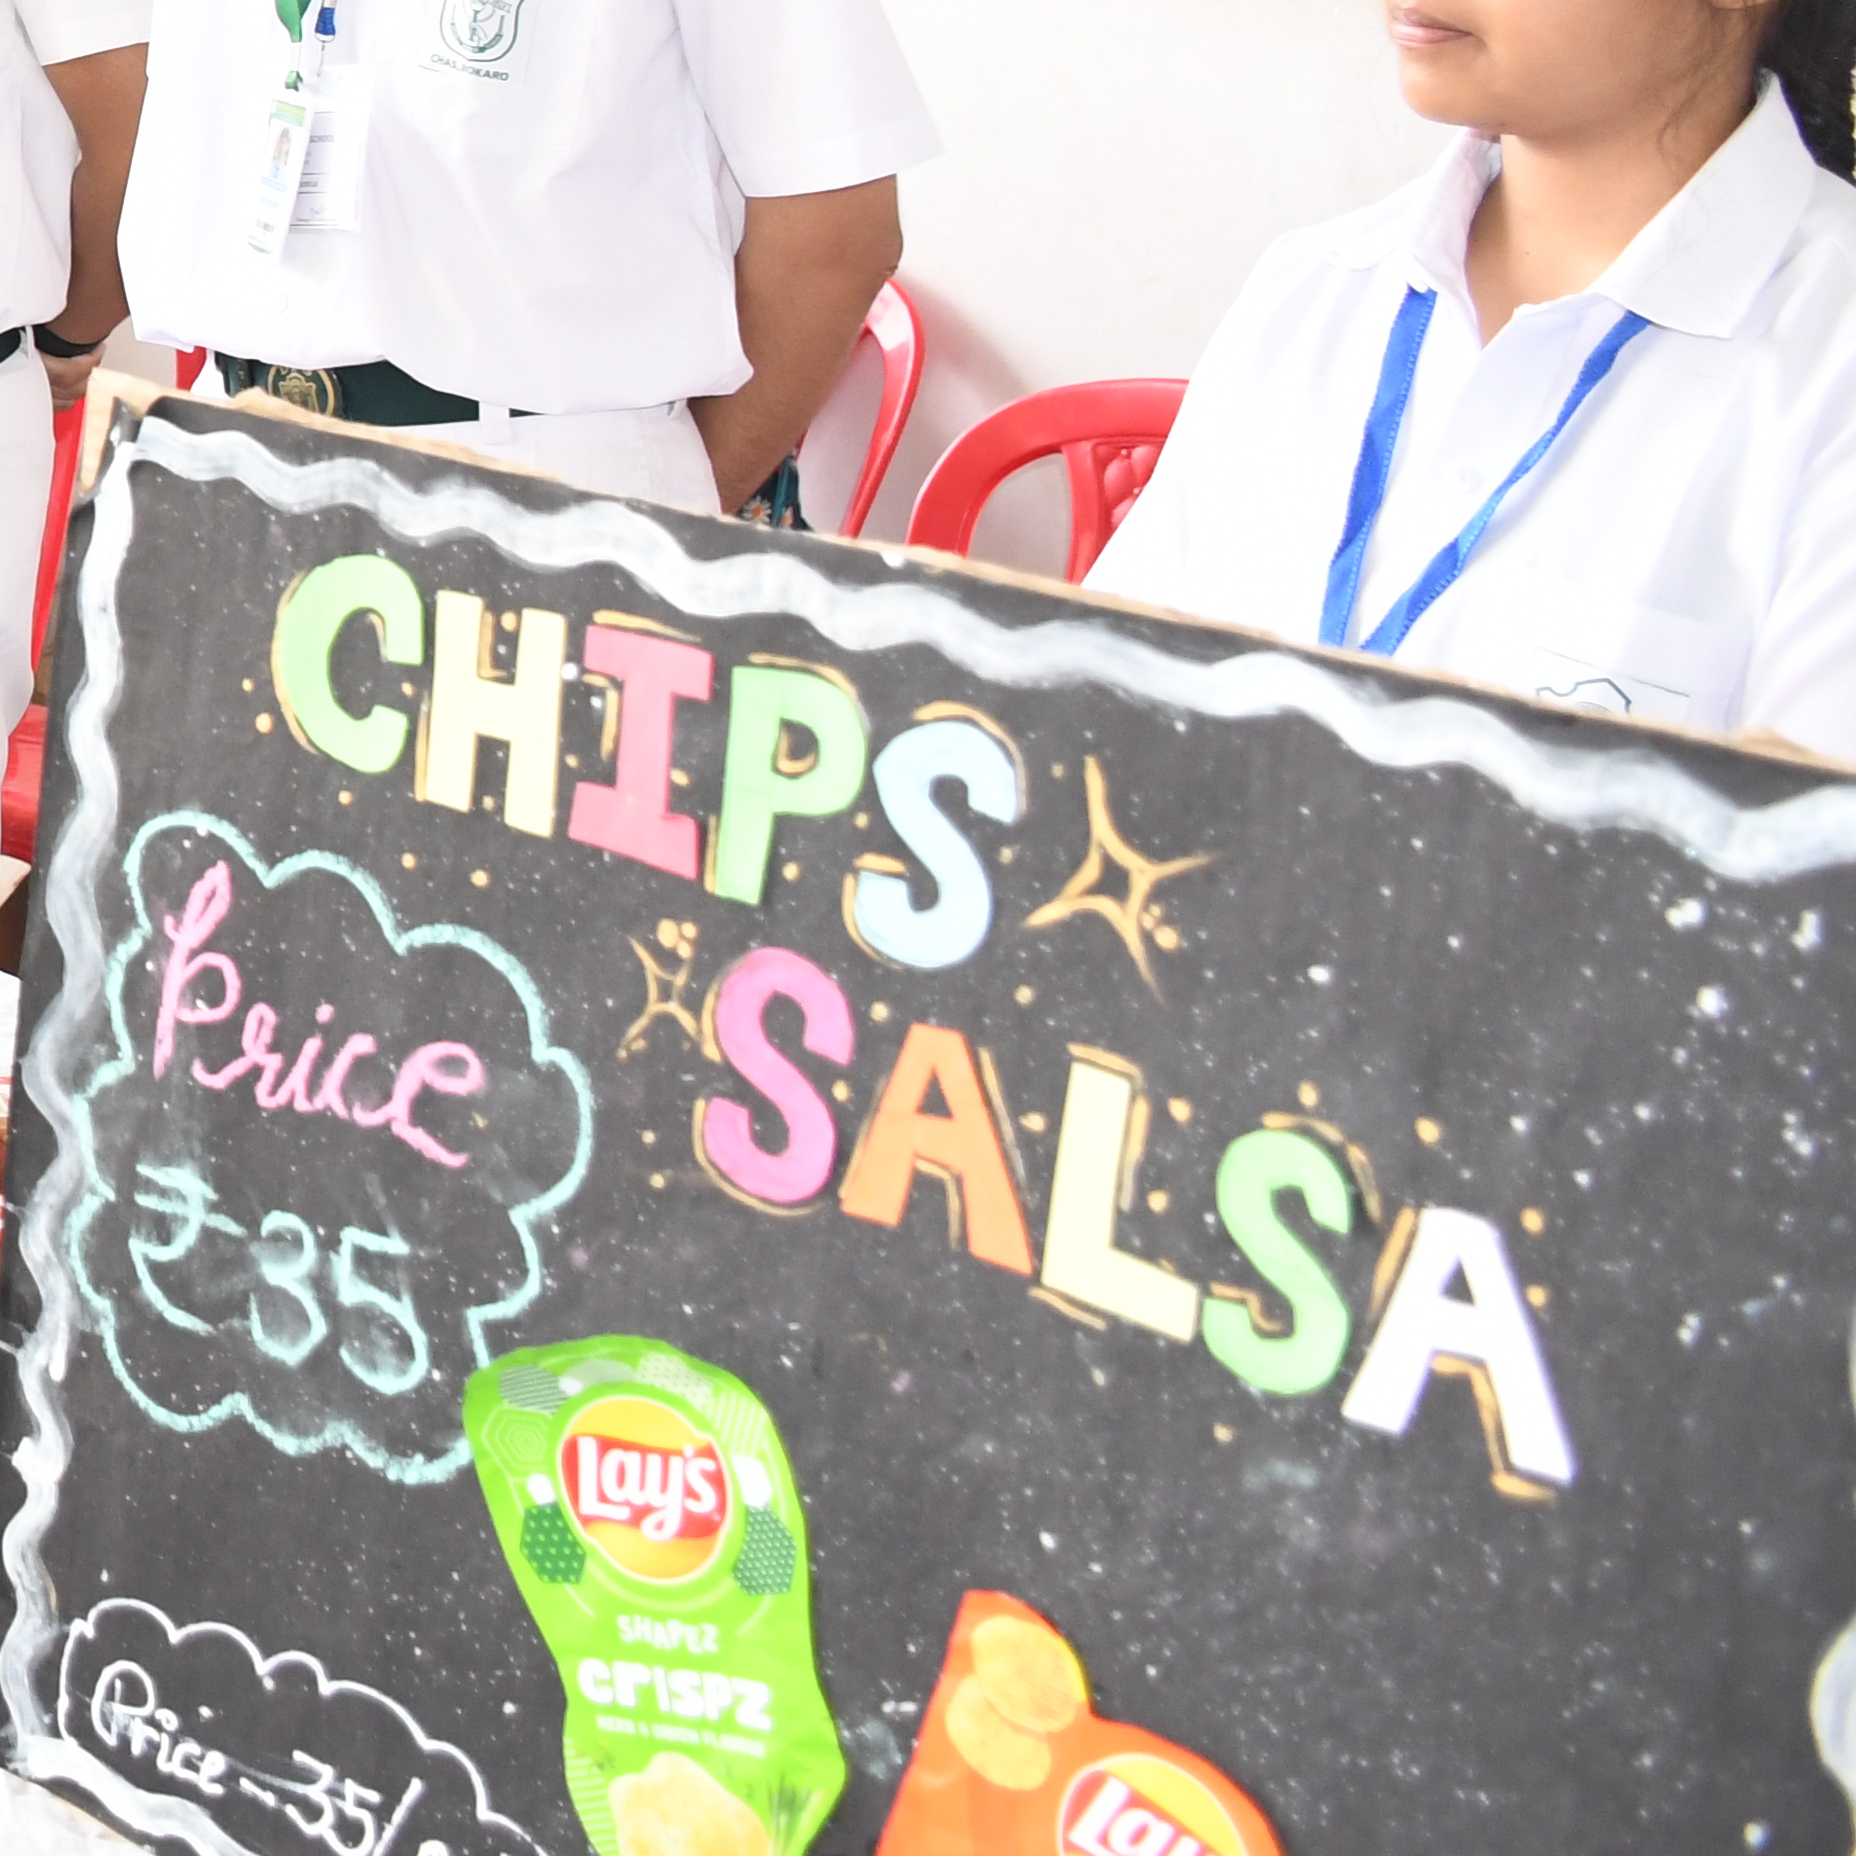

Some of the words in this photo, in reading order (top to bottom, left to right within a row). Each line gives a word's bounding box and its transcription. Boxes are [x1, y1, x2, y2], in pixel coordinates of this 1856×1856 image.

[288, 553, 1018, 969] CHIPS
[151, 860, 488, 1168] Price
[698, 948, 1576, 1487] SALSA
[575, 1436, 718, 1543] Lay's
[616, 1613, 720, 1655] SHAPEZ
